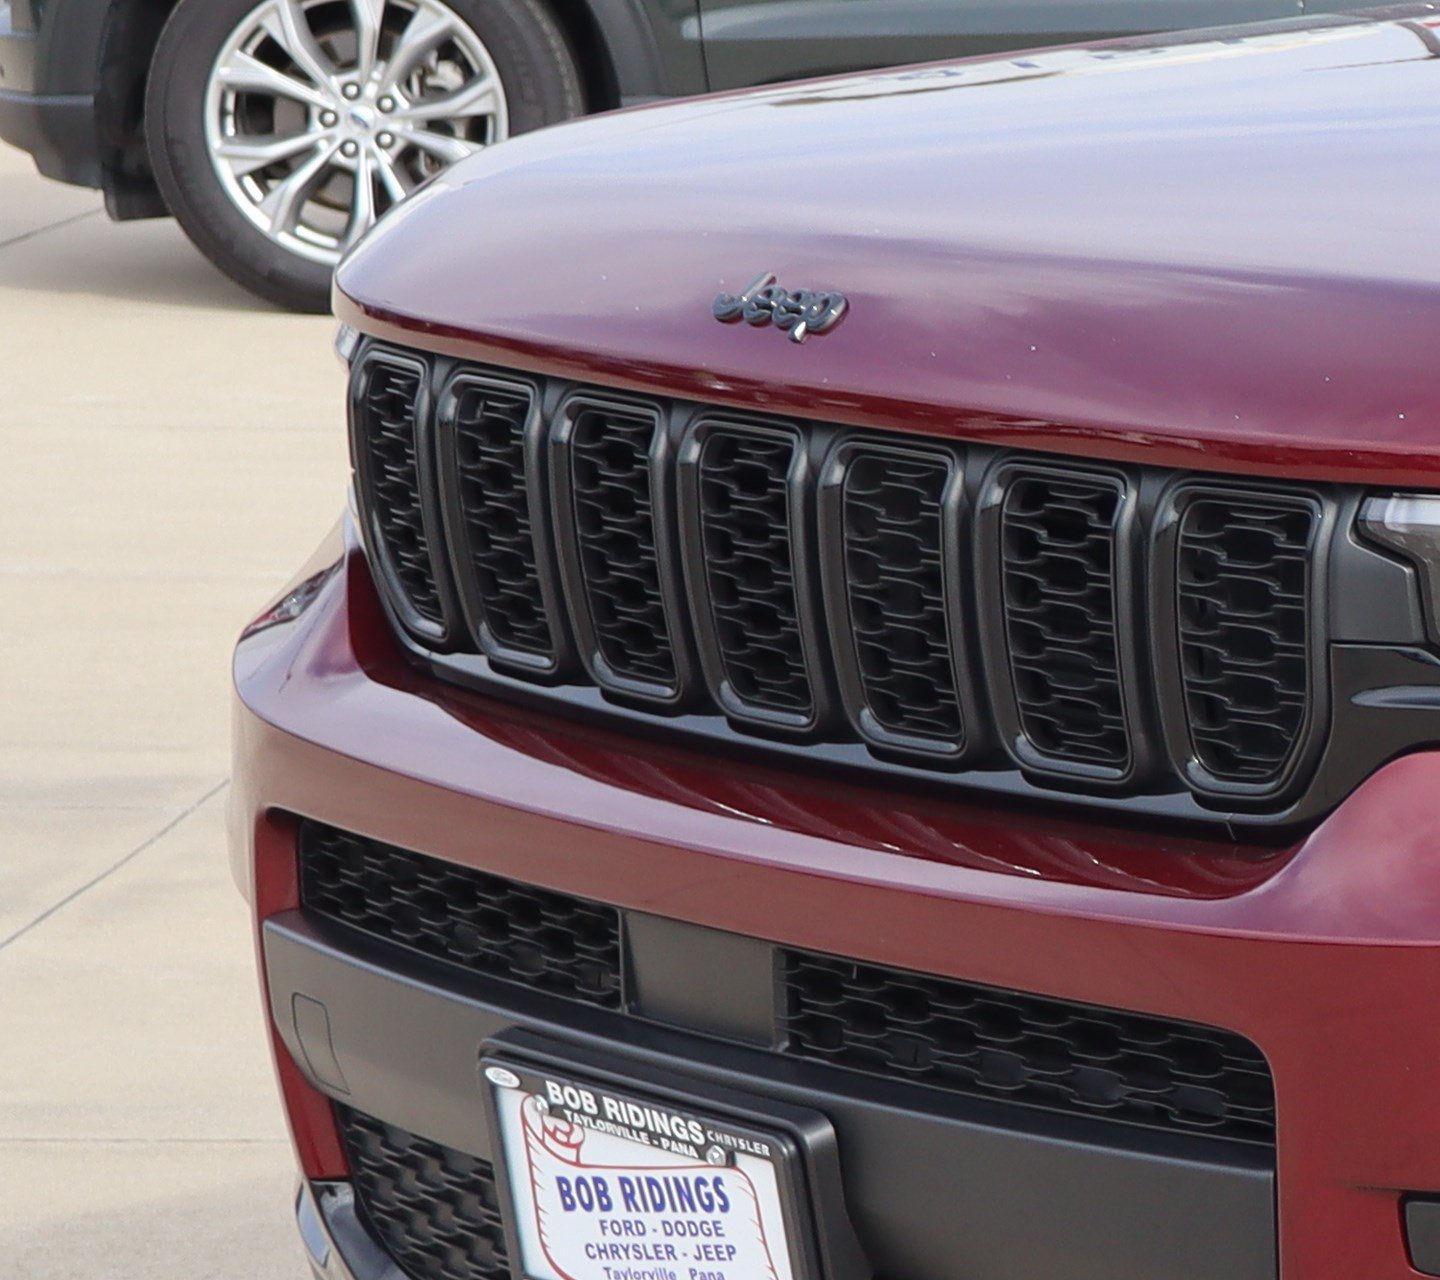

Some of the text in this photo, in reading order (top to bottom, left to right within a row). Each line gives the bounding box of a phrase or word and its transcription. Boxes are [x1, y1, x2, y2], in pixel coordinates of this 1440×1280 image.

[712, 271, 848, 343] Jeep
[545, 1079, 706, 1146] BOB RIDINGS
[562, 1108, 651, 1145] TAYLORVILLE
[660, 1136, 699, 1159] PANA
[706, 1129, 771, 1158] CHRYSLER
[555, 1175, 731, 1214] BOB RIDINGS
[599, 1219, 647, 1237] FORD
[661, 1219, 726, 1238] DODGE
[584, 1242, 679, 1261] CHRYSLER
[693, 1243, 737, 1262] JEEP
